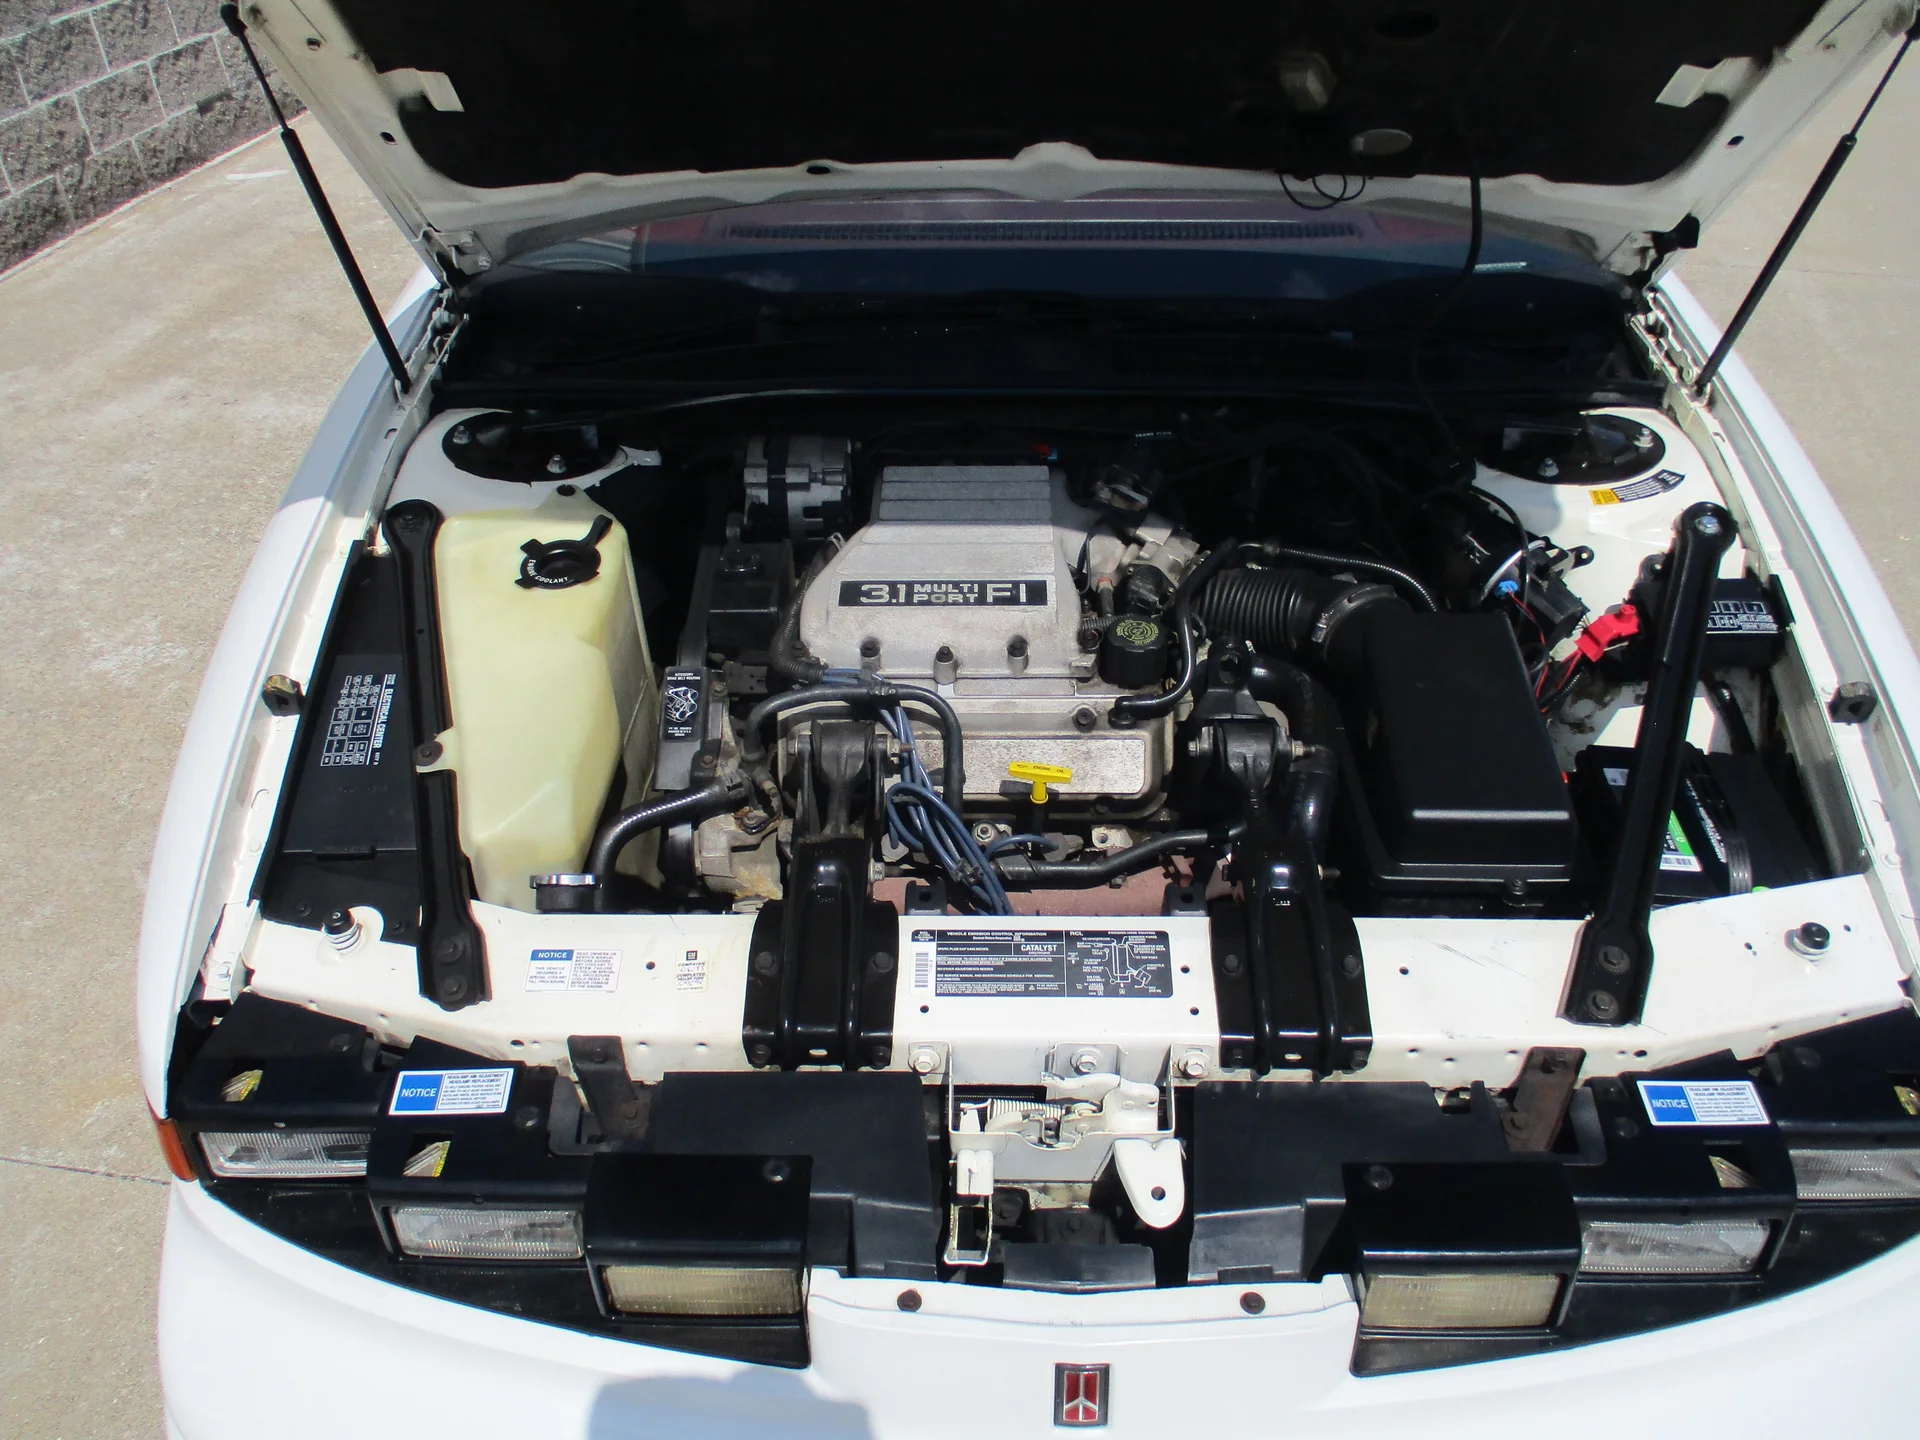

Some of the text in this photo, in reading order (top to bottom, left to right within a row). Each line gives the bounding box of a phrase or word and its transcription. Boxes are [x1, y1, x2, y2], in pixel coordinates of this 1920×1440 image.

[527, 559, 568, 584] ENGINE COOLANT
[860, 583, 1026, 603] 3.1 MULTI PORT FI
[378, 688, 393, 723] ELECTRICAL
[373, 724, 385, 748] CENTER
[537, 951, 568, 959] NOTICE
[1020, 944, 1058, 952] CATALYST
[401, 1088, 438, 1097] NOTICE
[1651, 1099, 1690, 1108] NOTICE
